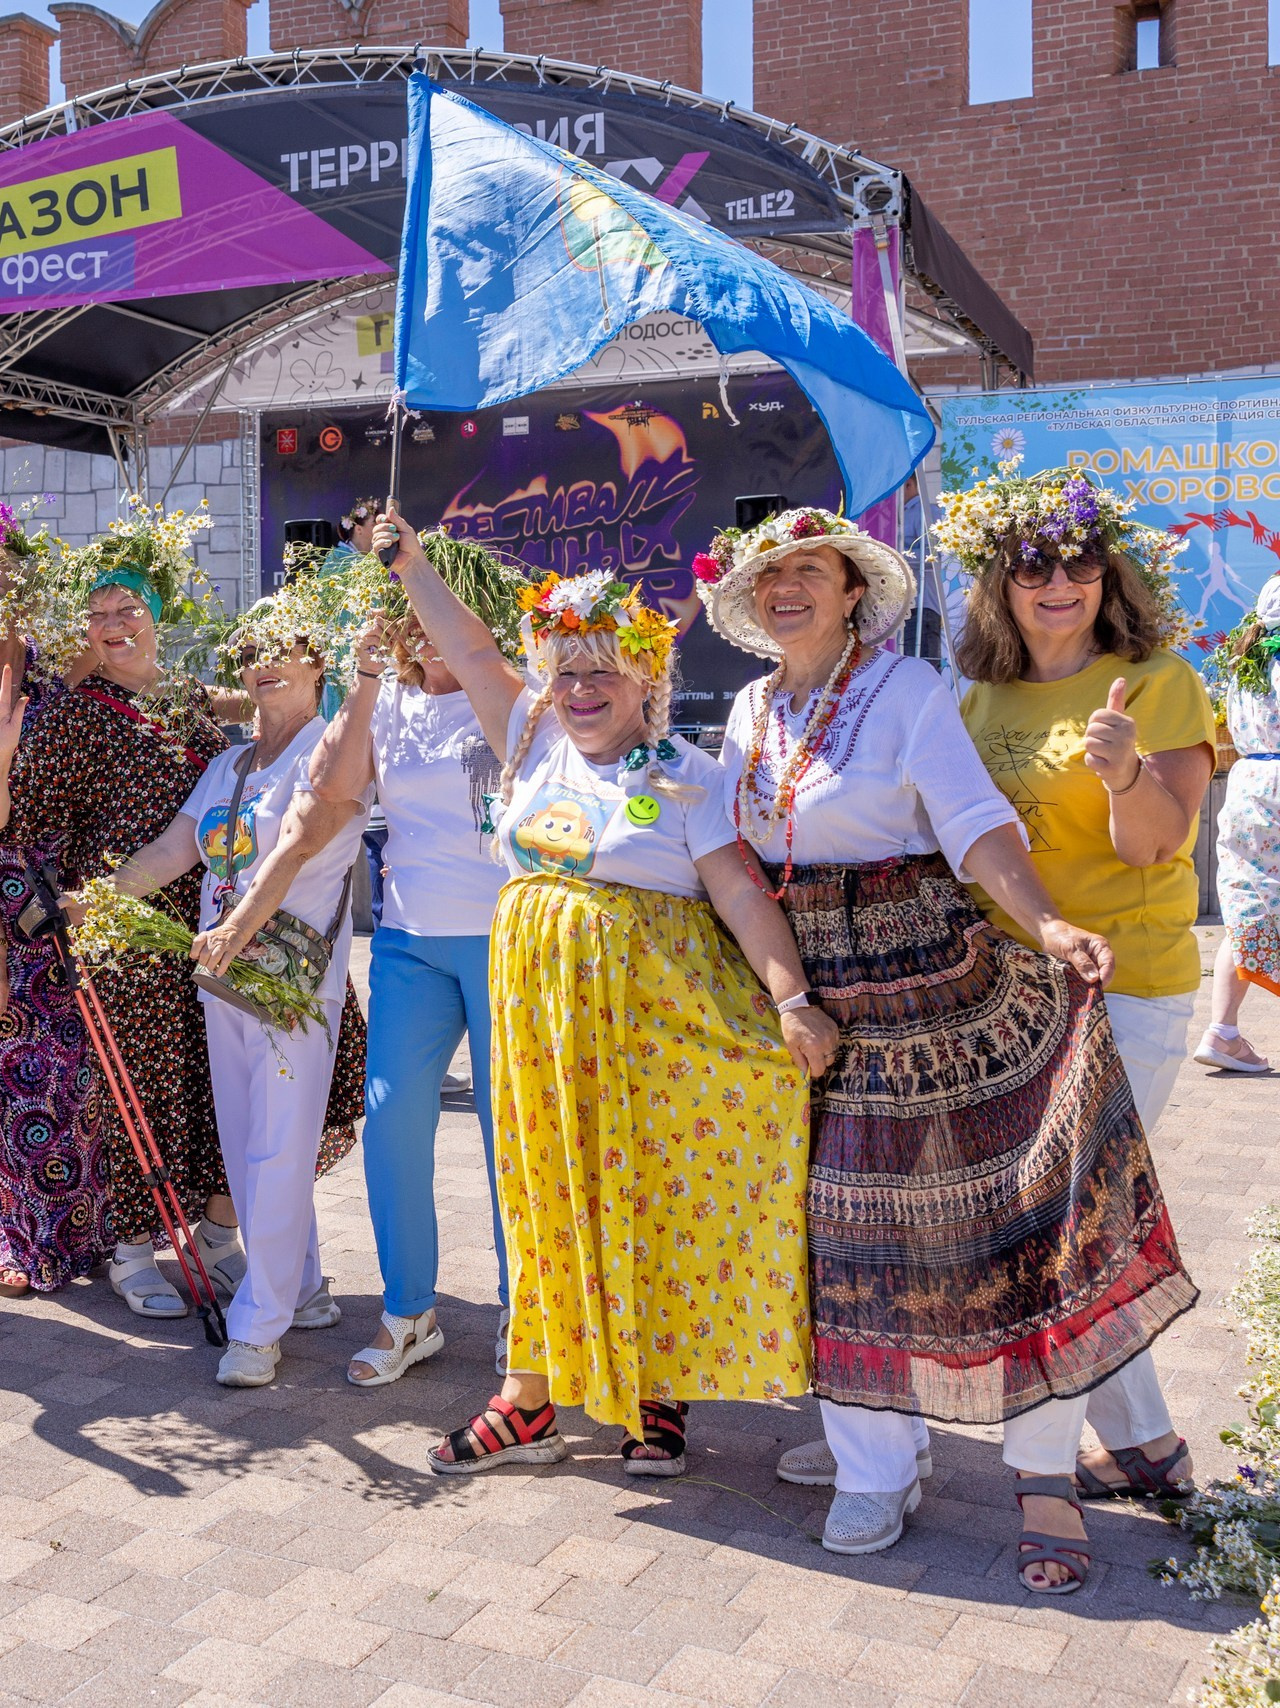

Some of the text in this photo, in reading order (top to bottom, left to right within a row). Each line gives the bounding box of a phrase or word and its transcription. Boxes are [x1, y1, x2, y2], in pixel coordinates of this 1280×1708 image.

[725, 189, 795, 220] TELE2
[1, 250, 109, 294] фест
[956, 399, 1280, 426] ТУЛЬСКАЯ РЕГИОНАЛЬНАЯ ФИЗКУЛЬТУРНО-СПОРТИВН
[1047, 419, 1111, 431] «ТУЛЬСКАЯ
[1114, 415, 1186, 427] ОБЛАСТНАЯ
[1189, 410, 1264, 424] ФЕДЕРАЦИЯ
[1067, 440, 1280, 475] РОМАШКО
